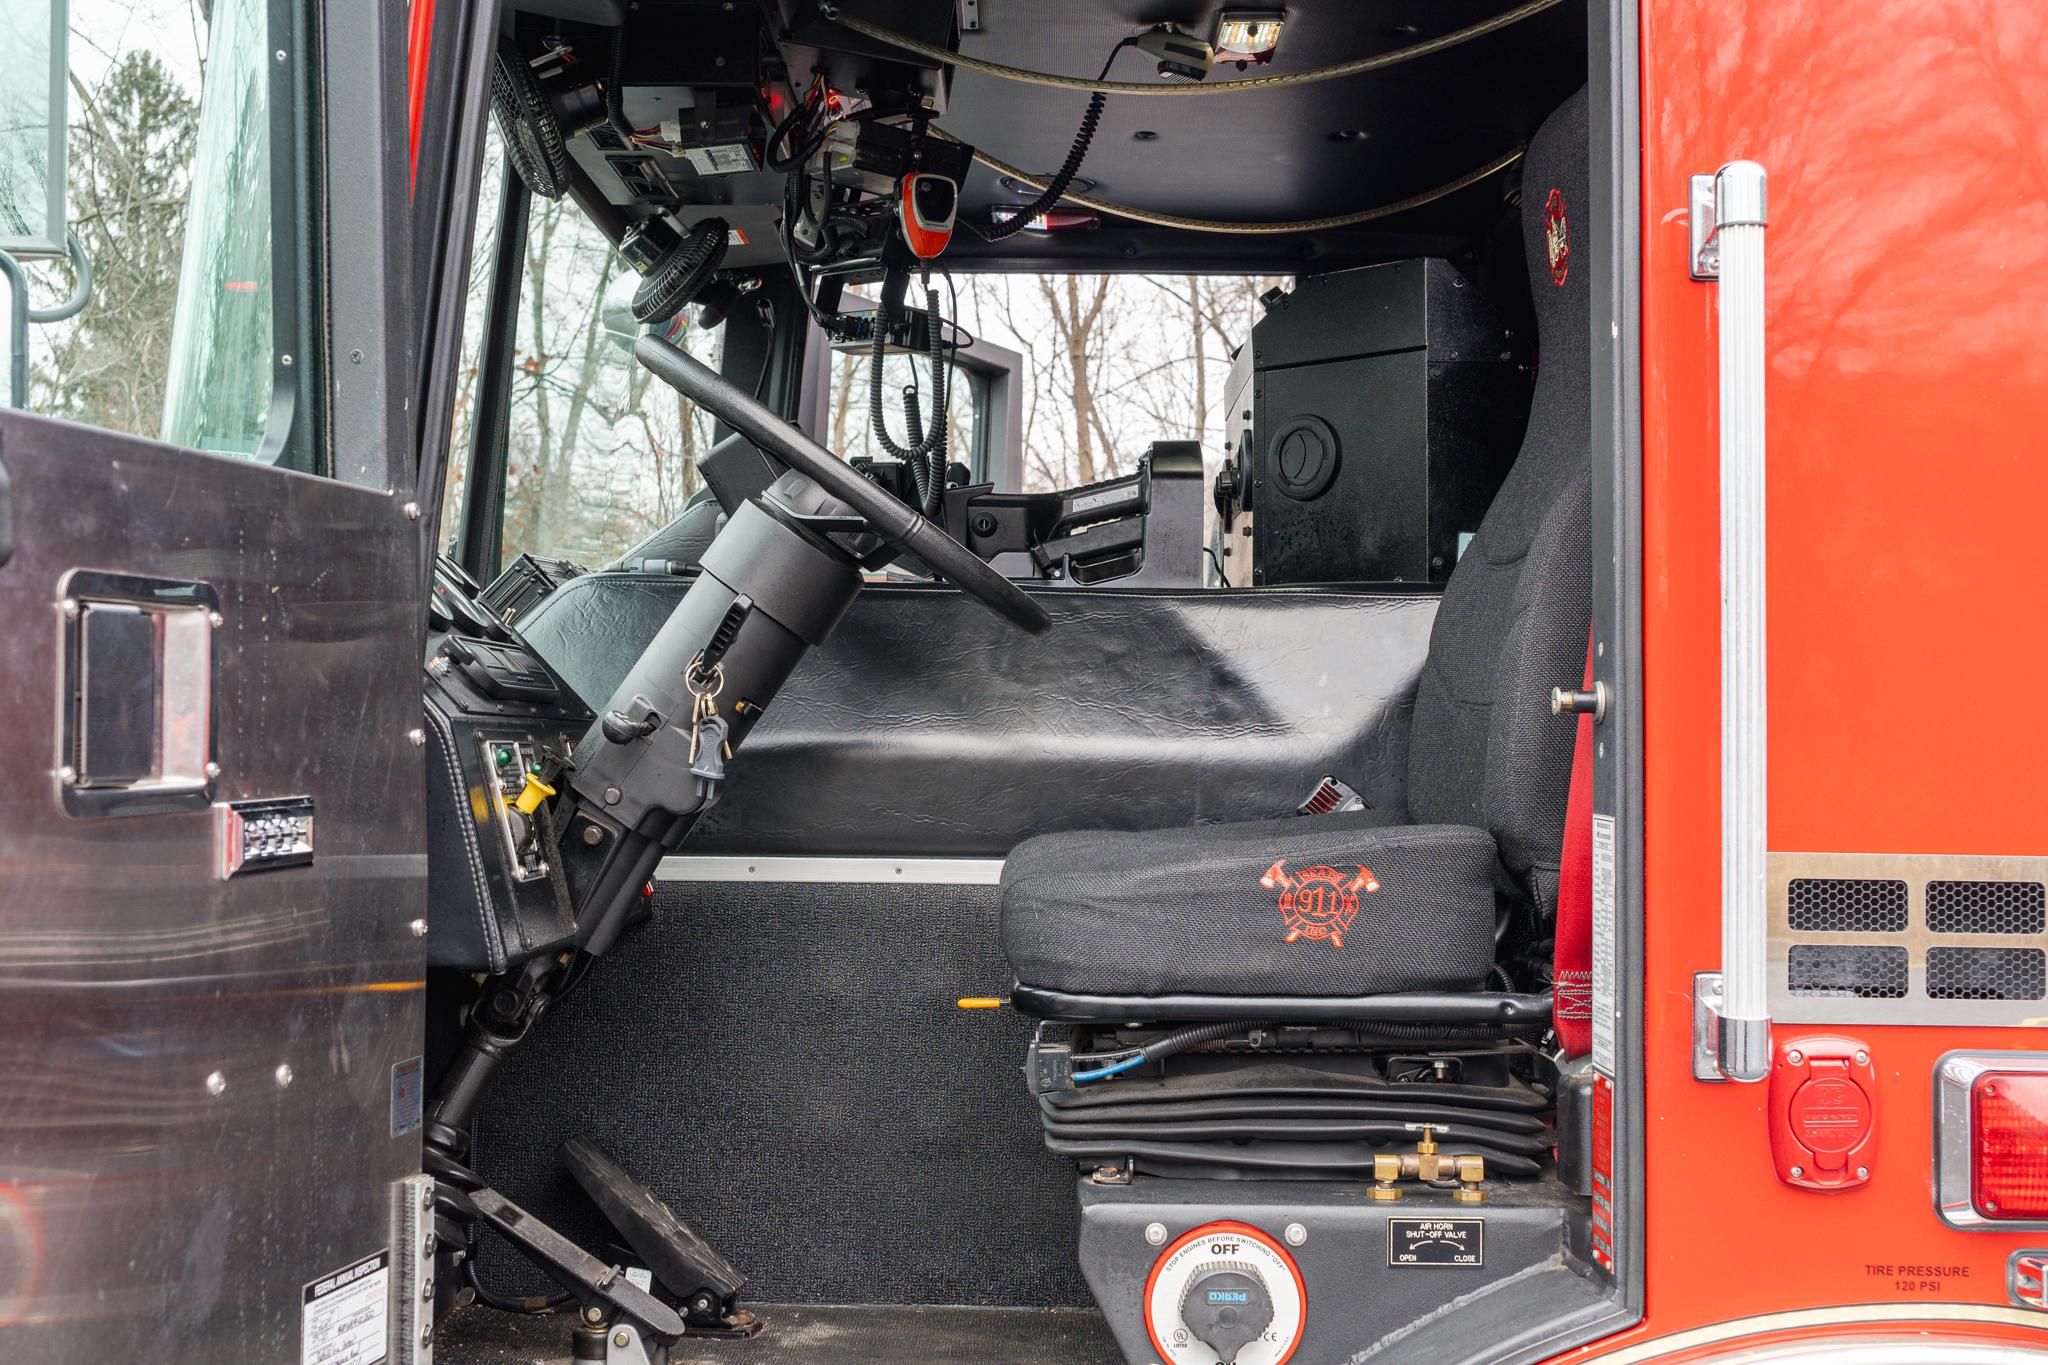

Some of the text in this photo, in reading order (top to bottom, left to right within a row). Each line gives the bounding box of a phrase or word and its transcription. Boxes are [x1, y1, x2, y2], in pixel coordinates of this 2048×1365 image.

[1299, 886, 1339, 918] 911
[1405, 1230, 1467, 1239] SHUT-OFF VALVE
[1166, 1255, 1180, 1272] STOP
[1180, 1240, 1207, 1258] ENGINES
[1207, 1236, 1235, 1244] BEFORE
[1236, 1236, 1271, 1257] SWITCHING
[1211, 1243, 1240, 1255] OFF
[1399, 1254, 1476, 1263] OPEN CLOSE
[1865, 1264, 1970, 1277] TIRE PRESSURE
[1895, 1281, 1941, 1292] 120 PSI
[1208, 1291, 1247, 1302] PERKO
[1263, 1331, 1277, 1342] CE
